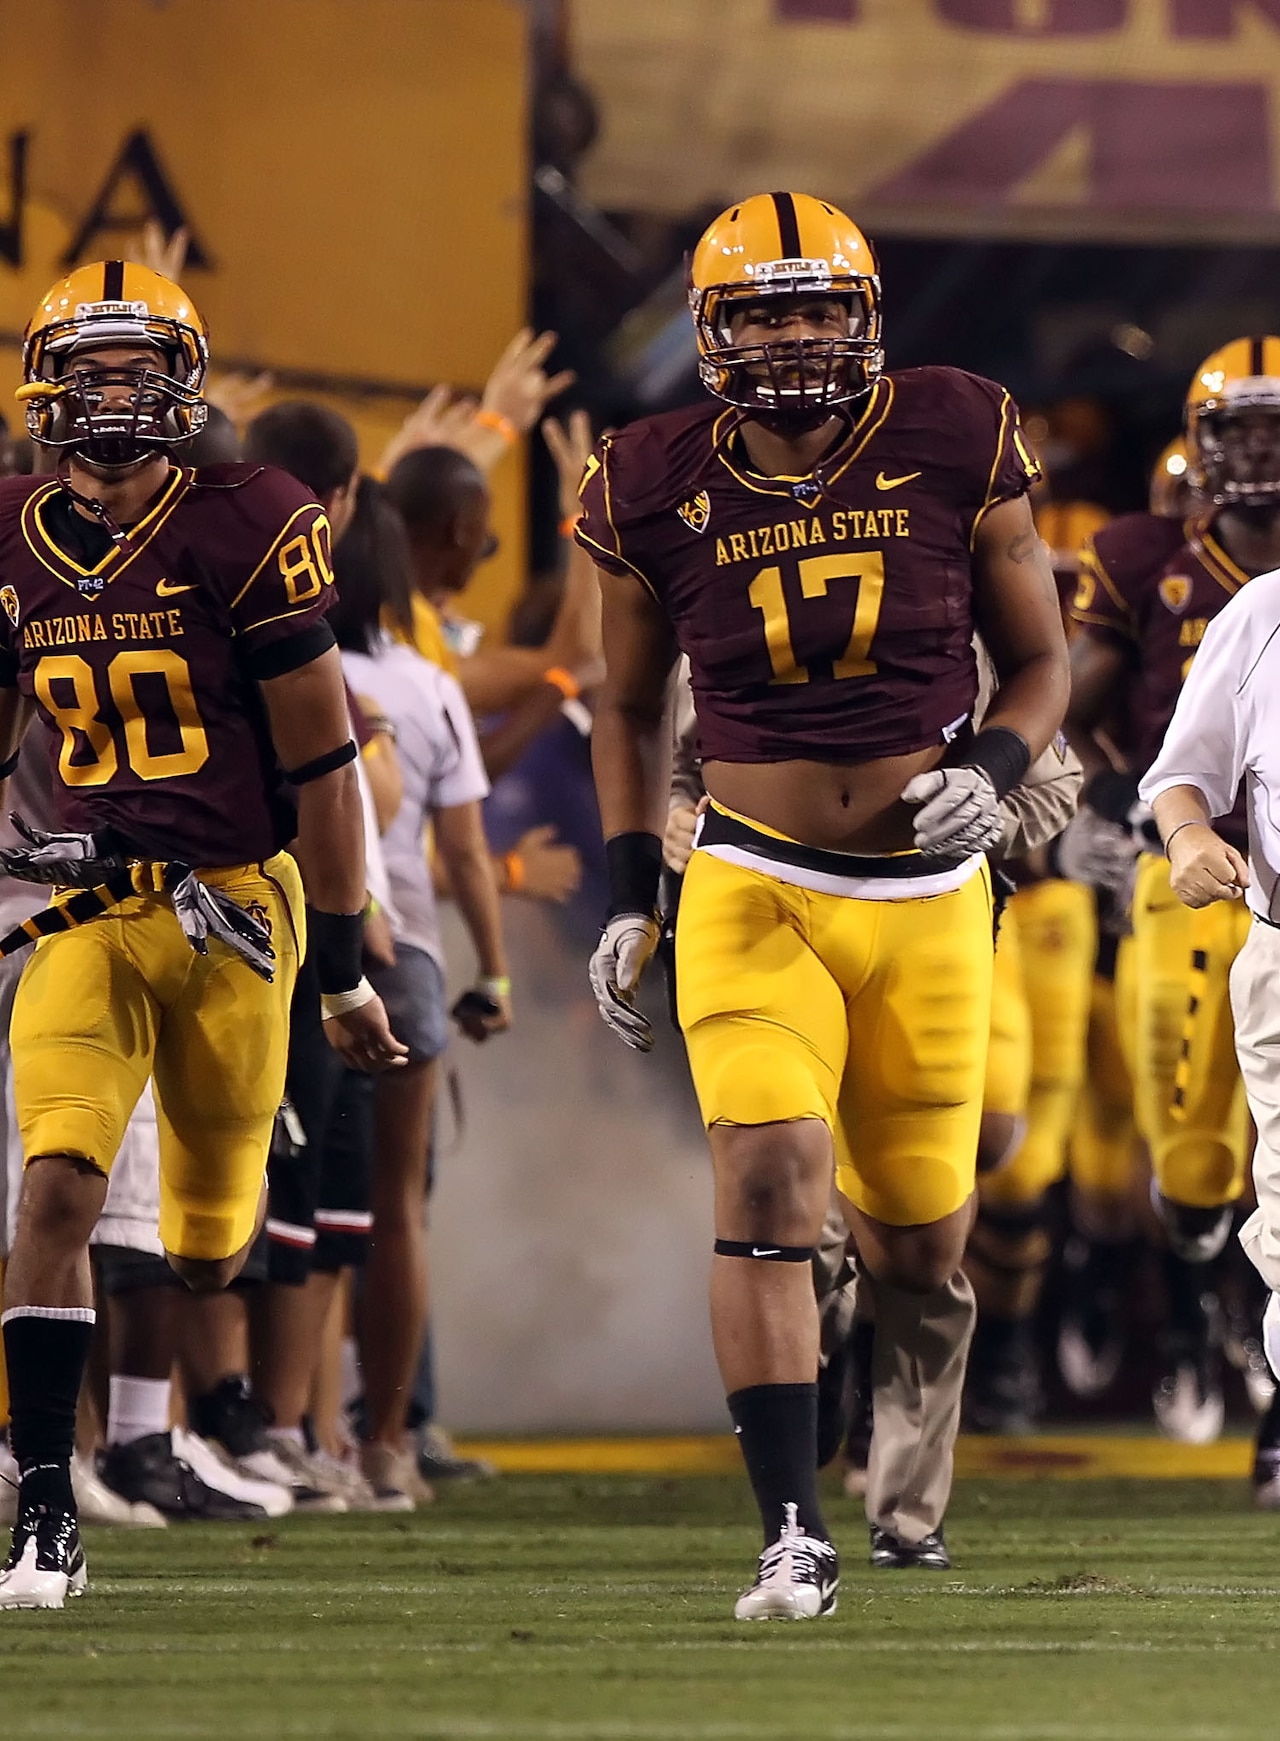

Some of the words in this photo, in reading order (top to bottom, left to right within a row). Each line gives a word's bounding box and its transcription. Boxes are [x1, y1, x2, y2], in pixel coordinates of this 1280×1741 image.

[0, 126, 212, 270] A
[278, 513, 335, 604] 80
[715, 517, 826, 566] ARIZONA
[832, 508, 910, 540] STATE
[23, 614, 108, 649] ARIZONA
[112, 608, 185, 640] STATE
[748, 550, 885, 685] 17
[34, 649, 209, 787] 80
